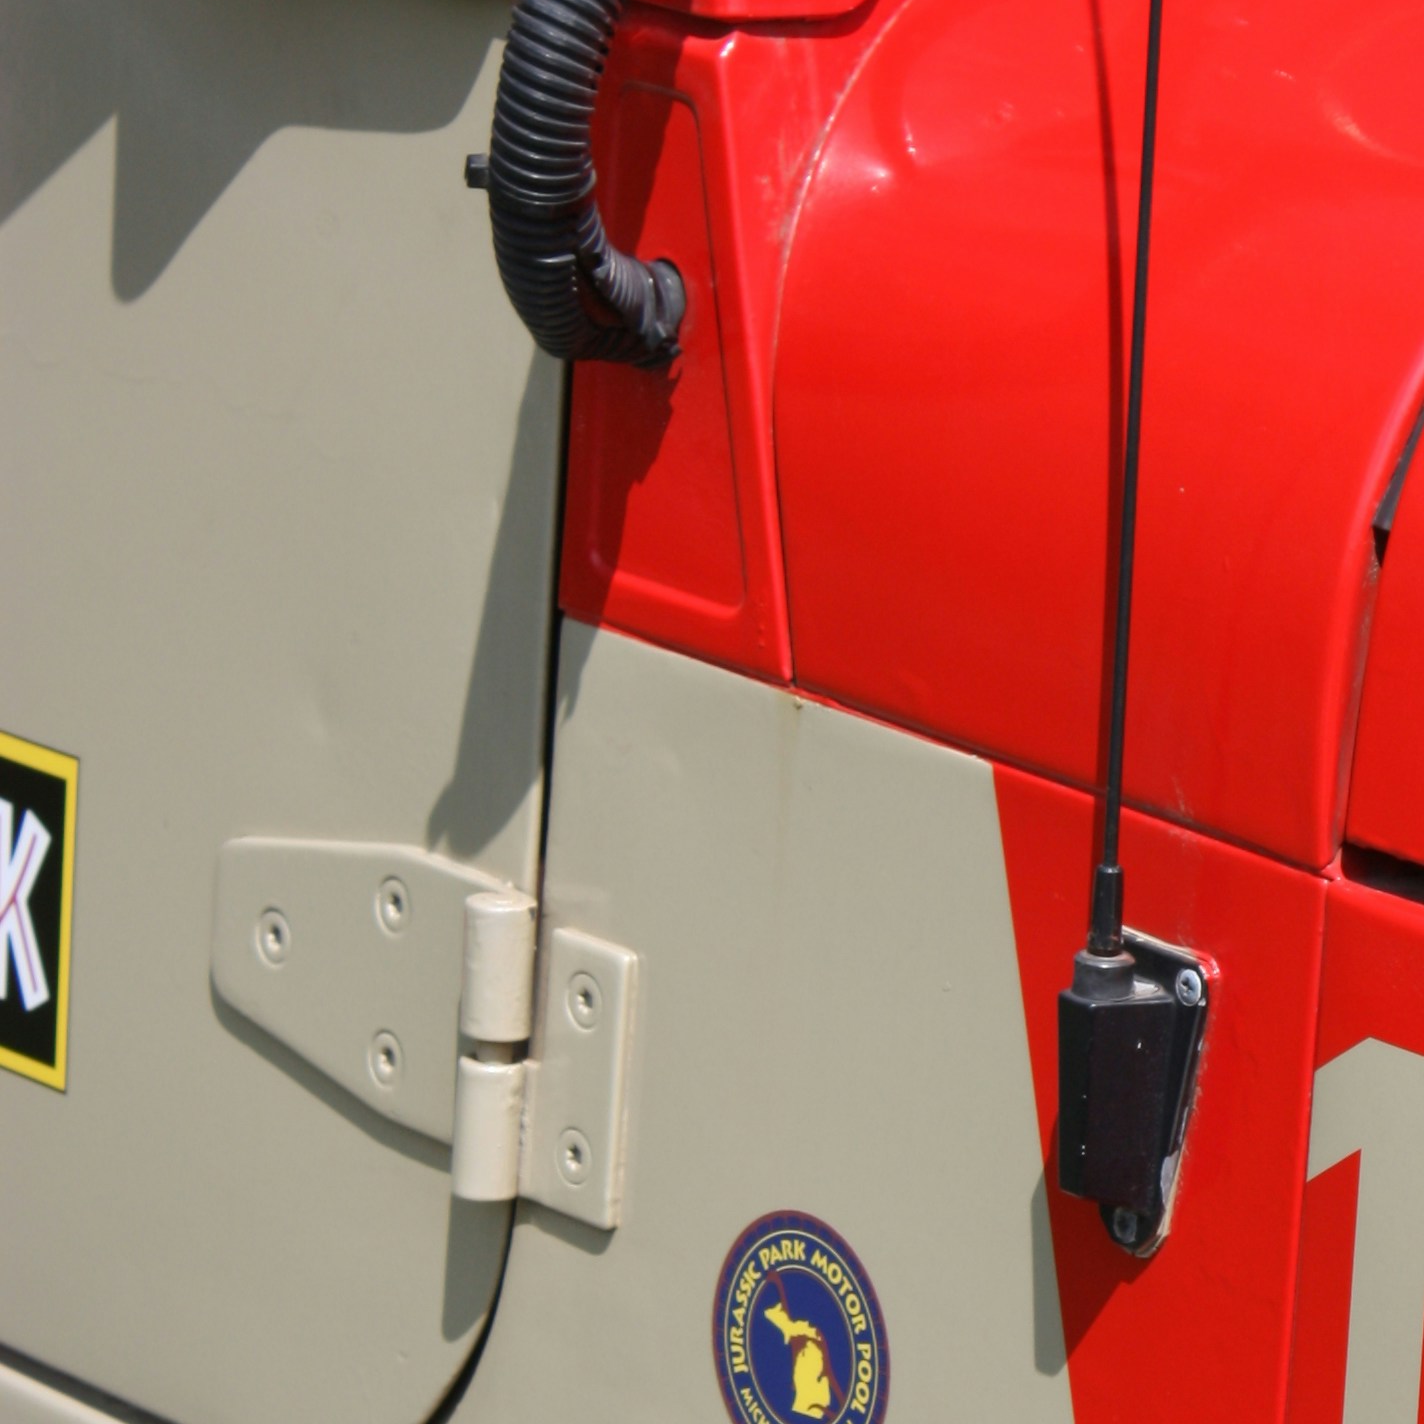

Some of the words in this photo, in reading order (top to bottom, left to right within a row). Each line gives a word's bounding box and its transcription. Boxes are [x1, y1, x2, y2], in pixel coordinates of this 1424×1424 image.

[730, 1261, 762, 1373] JURASSIC
[759, 1239, 806, 1271] PARK
[811, 1250, 867, 1335] MOTOR
[850, 1343, 873, 1415] POOL
